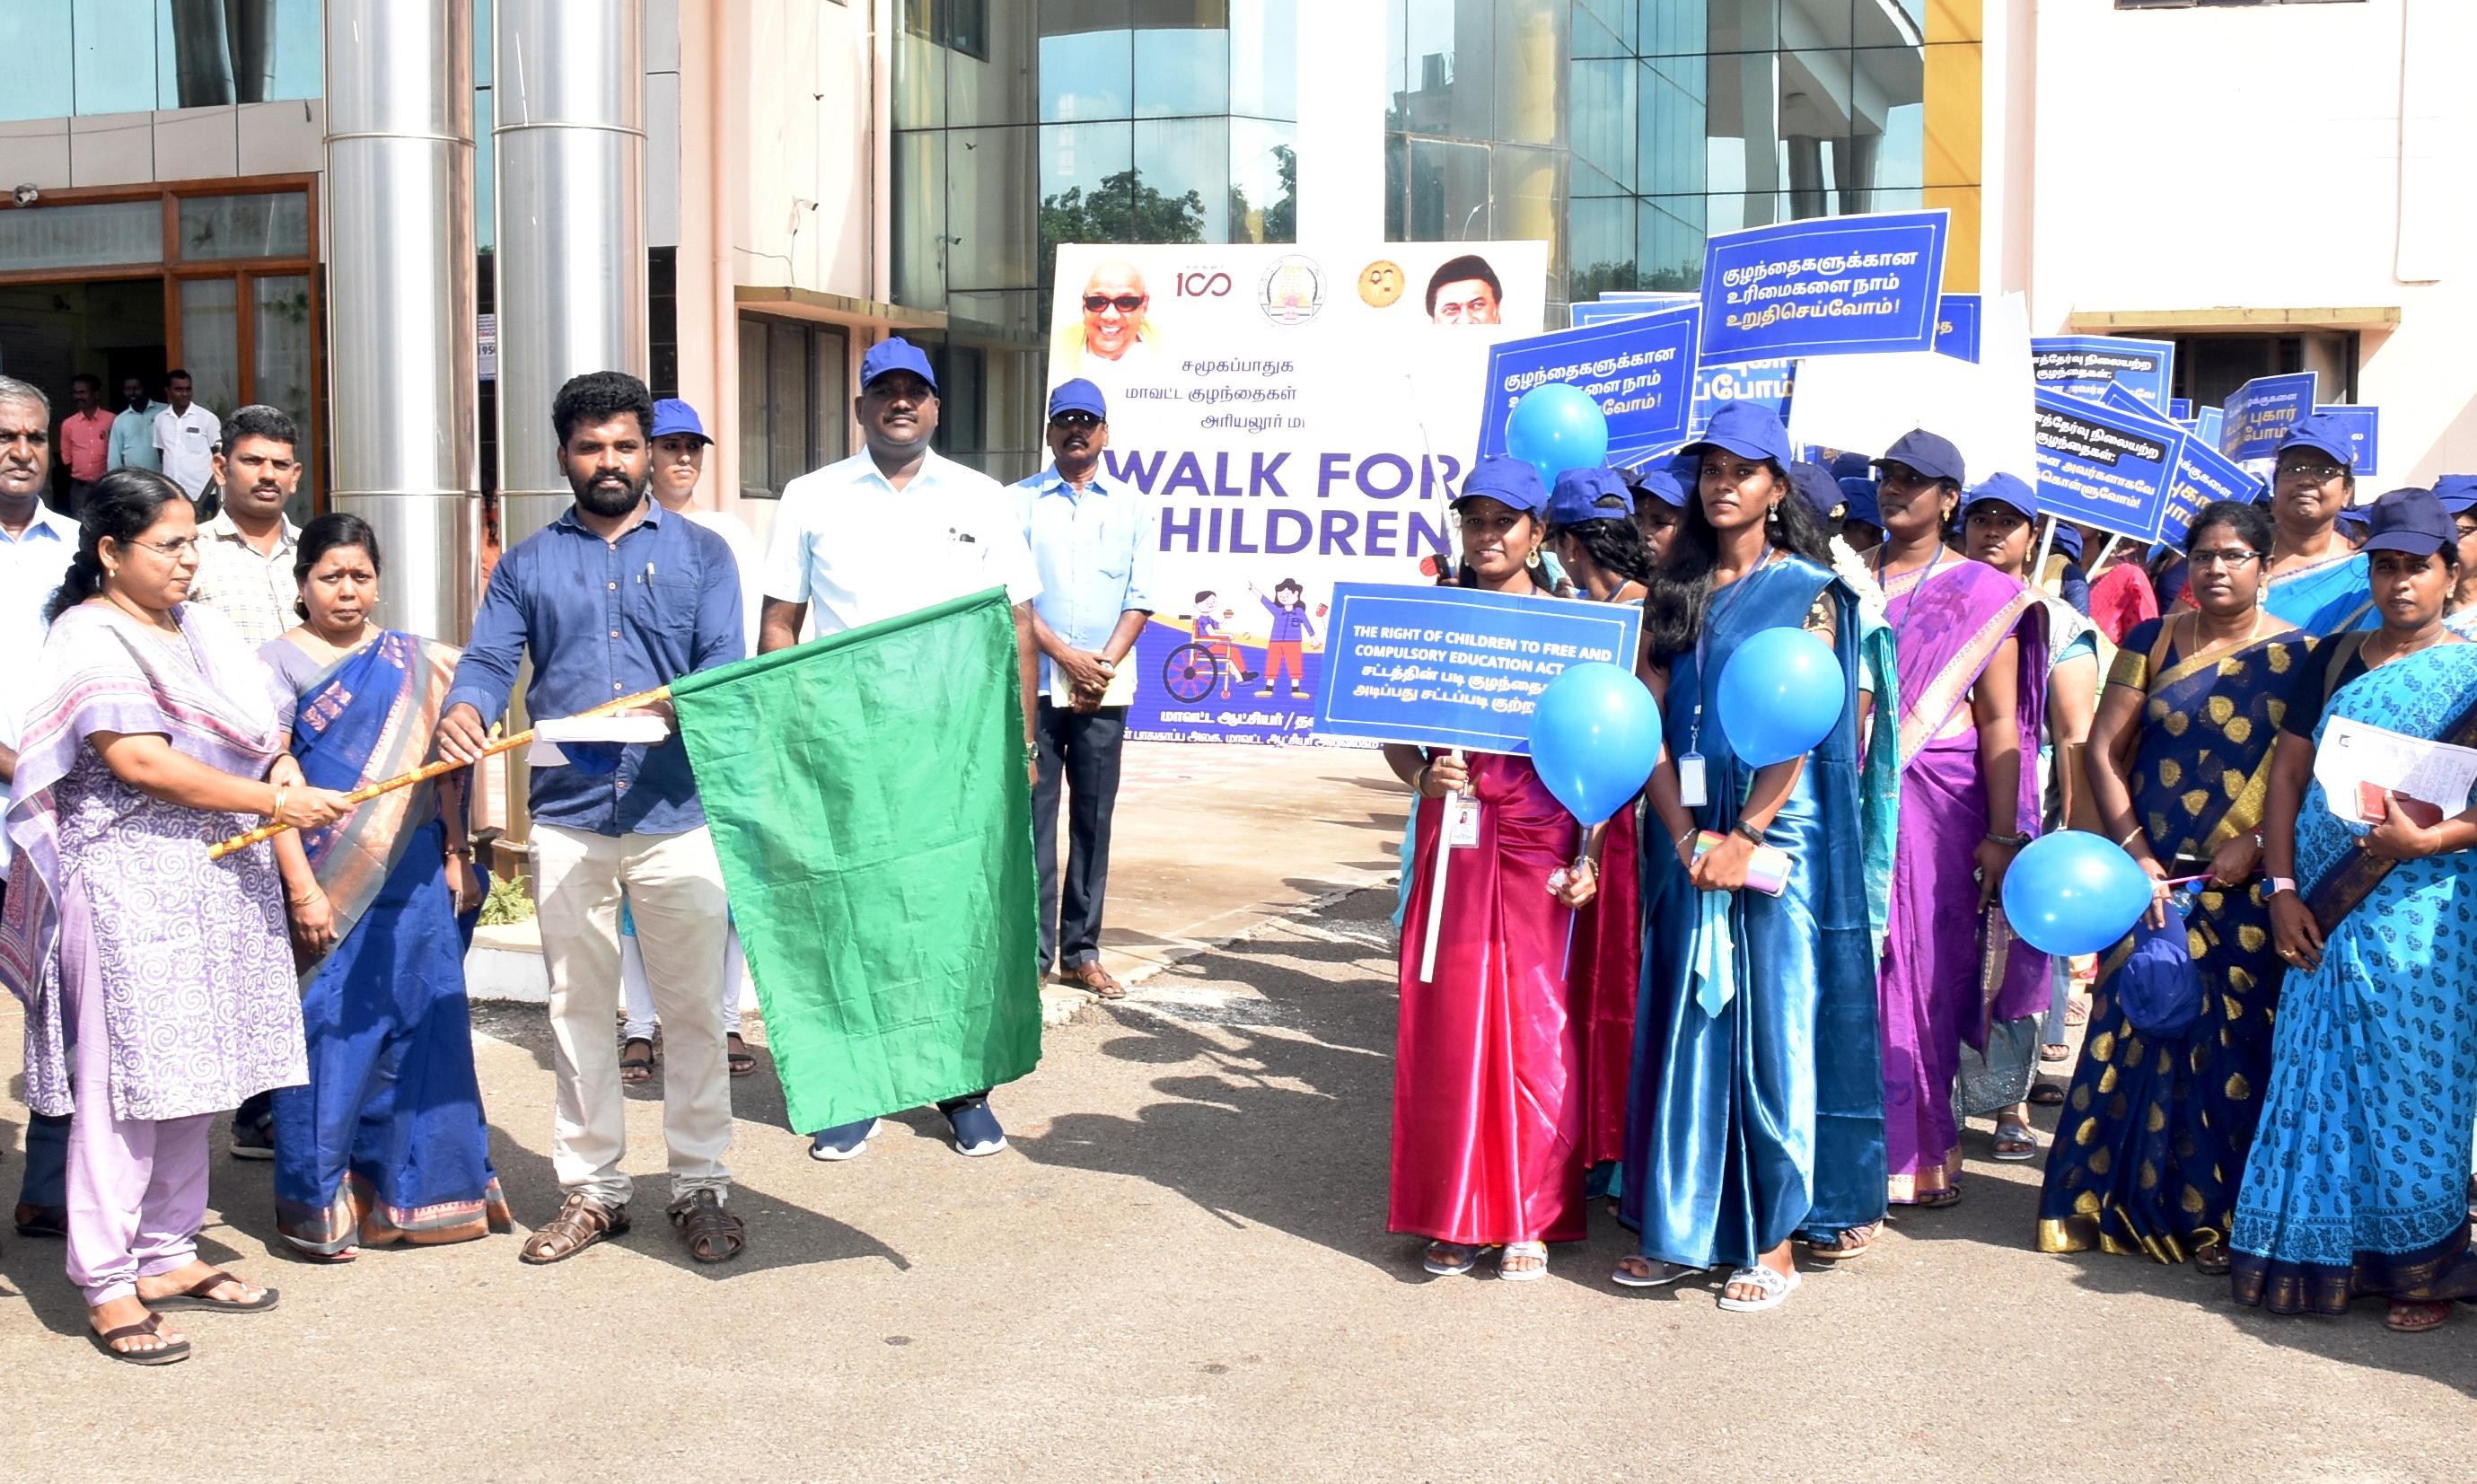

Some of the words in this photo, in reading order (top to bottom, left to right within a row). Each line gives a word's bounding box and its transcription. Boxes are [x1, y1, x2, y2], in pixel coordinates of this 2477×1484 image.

[1722, 250, 1919, 286] குழந்தைகளுக்கான
[1726, 277, 1852, 305] உரிமைகளை
[1852, 273, 1900, 298] நாம்
[1181, 357, 1294, 377] சமூகப்பாதுக
[1504, 347, 1677, 392] குழந்தைகளுக்கான
[1622, 369, 1662, 396] நாம்
[1126, 387, 1183, 400] மாவட்ட
[1188, 385, 1297, 405] குழந்தைகள்
[1200, 413, 1282, 434] அரியலூர்
[2251, 404, 2297, 426] புகார்
[1102, 450, 1292, 496] WALK
[1317, 452, 1461, 500] FOR
[1159, 506, 1452, 558] HILDREN
[1353, 625, 1378, 638] THE
[1381, 627, 1422, 641] RIGHT
[1423, 629, 1444, 642] OF
[1445, 631, 1517, 651] CHILDREN
[1520, 639, 1541, 654] TO
[1542, 642, 1577, 658] FREE
[1577, 646, 1612, 662] AND
[1355, 644, 1447, 663] COMPULSORY
[1449, 651, 1533, 672] EDUCATION
[1534, 661, 1565, 676] ACT
[1361, 663, 1439, 682] சட்டத்தின்
[1440, 672, 1465, 688] படி
[1468, 675, 1549, 697] குழந்தை
[1353, 683, 1419, 703] அடிப்பது
[1420, 687, 1489, 710] சட்டப்படி
[1490, 696, 1536, 716] குற்ற
